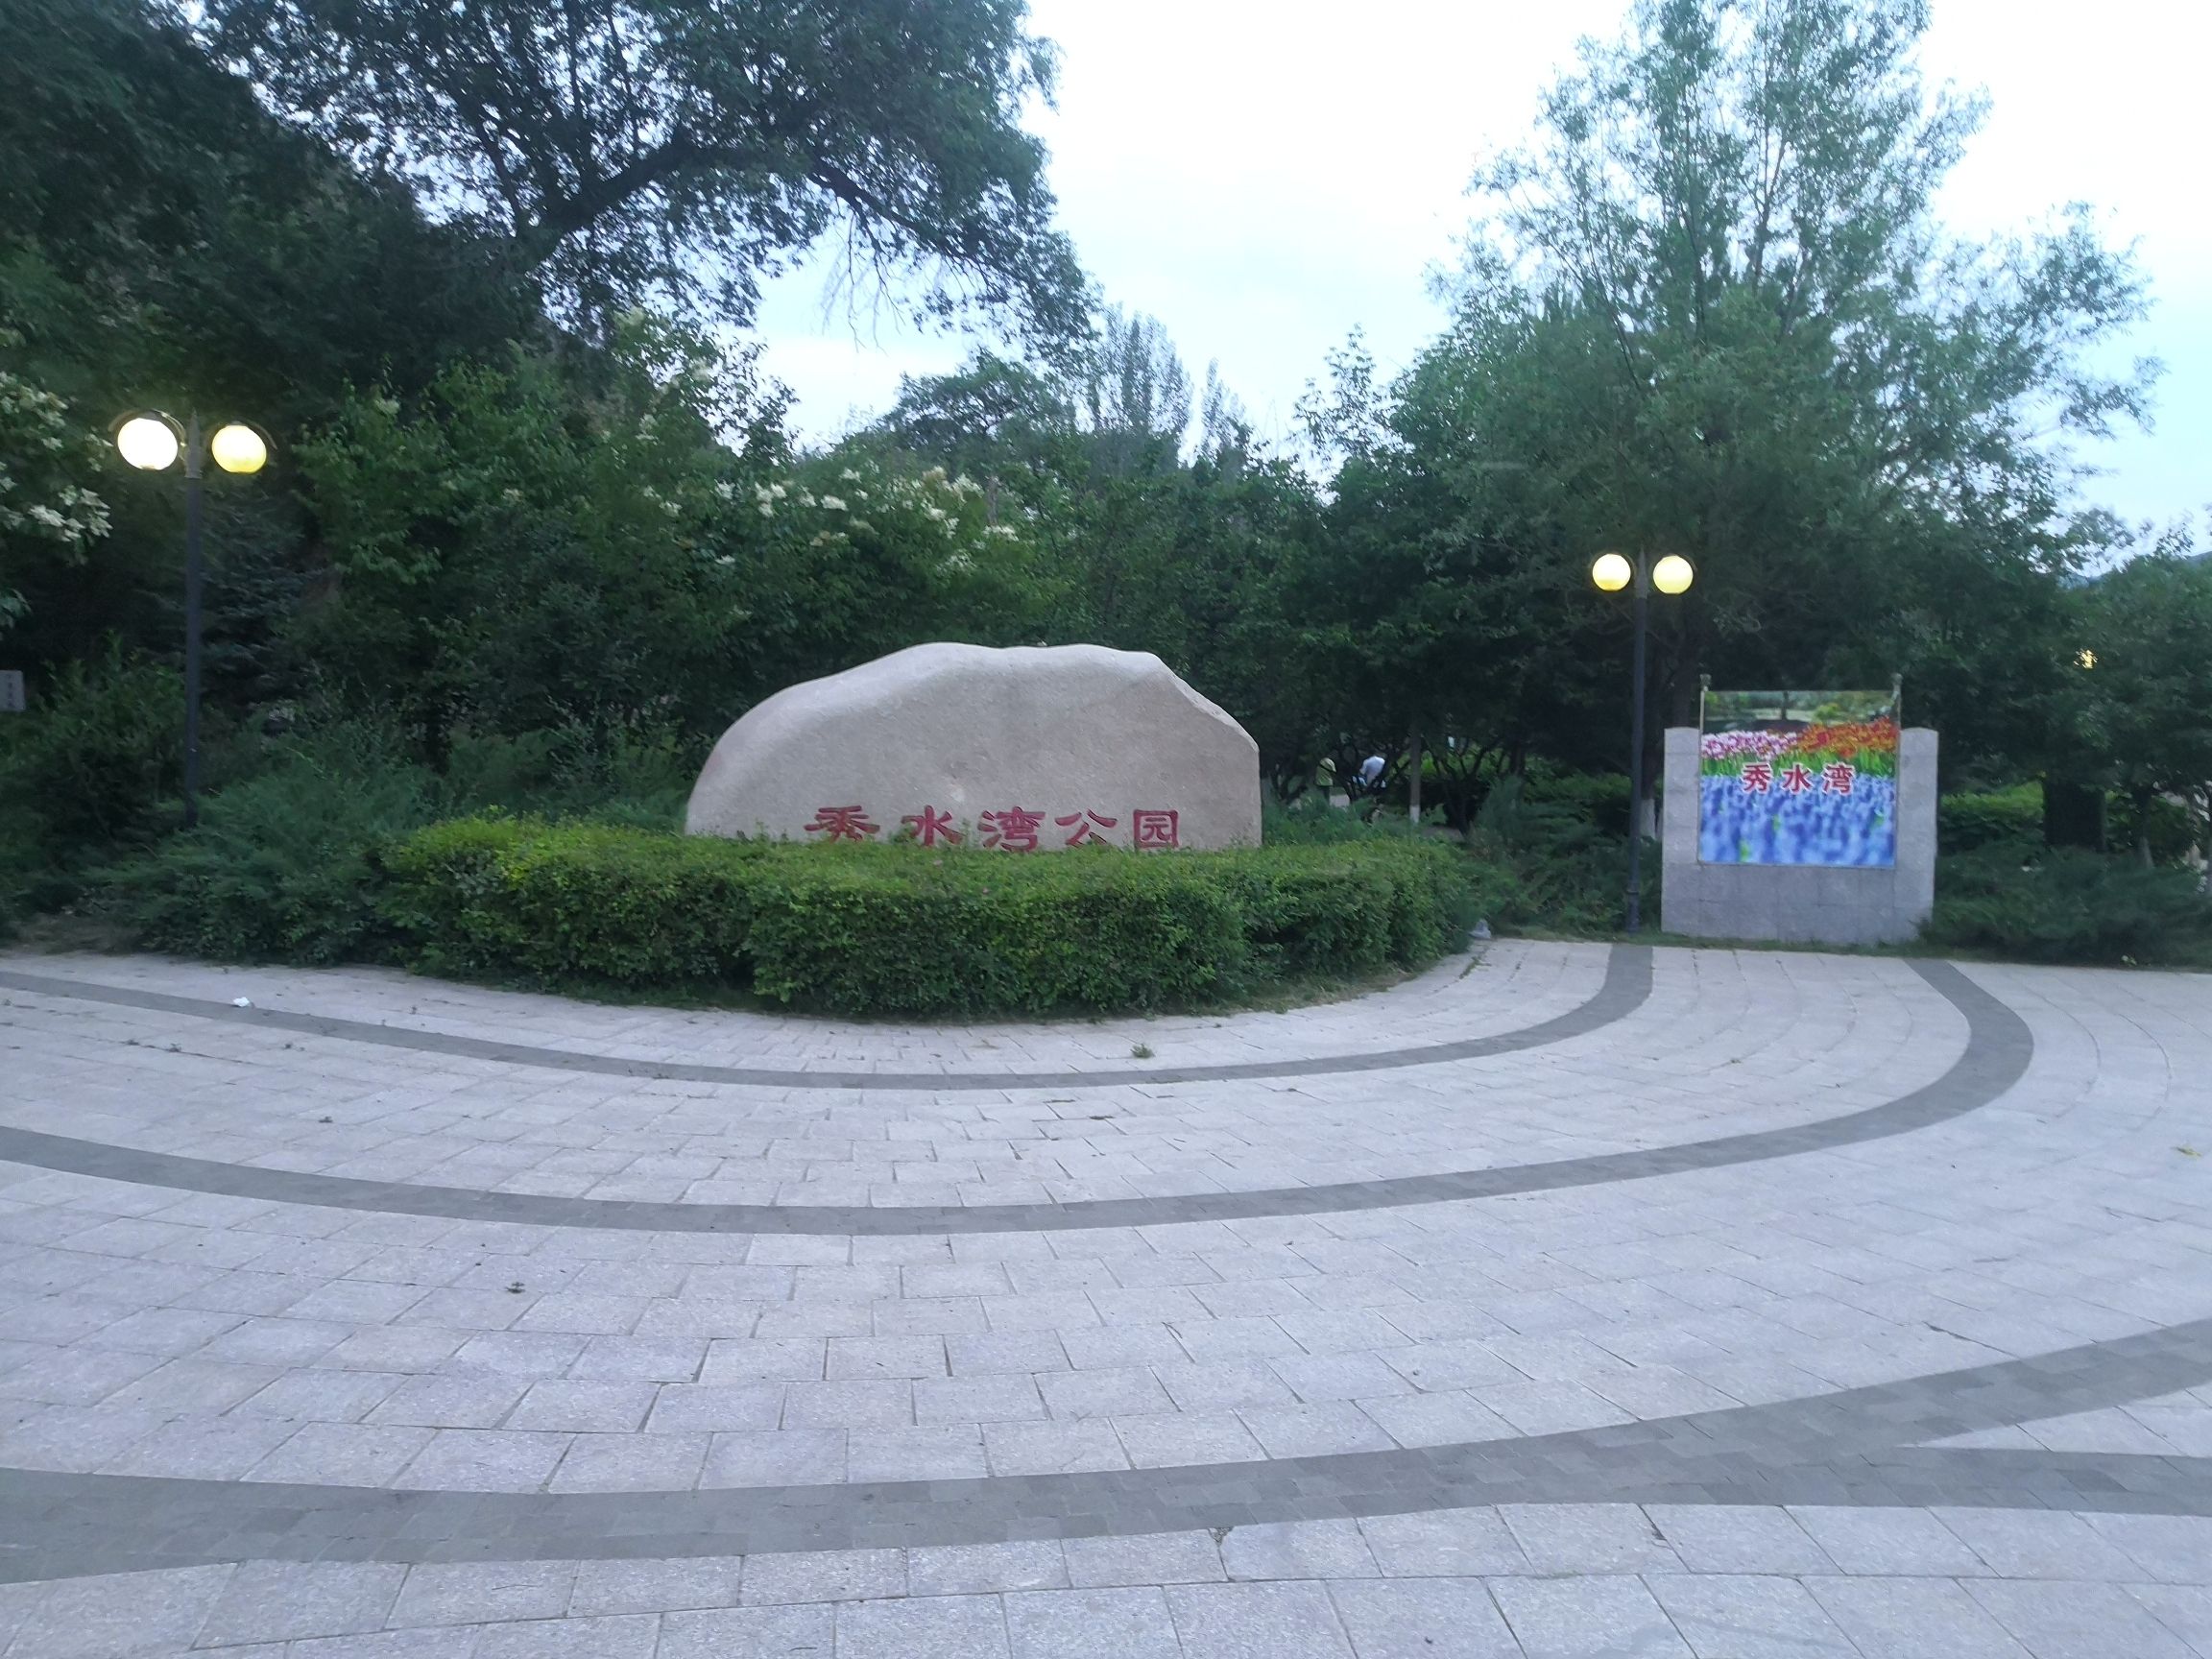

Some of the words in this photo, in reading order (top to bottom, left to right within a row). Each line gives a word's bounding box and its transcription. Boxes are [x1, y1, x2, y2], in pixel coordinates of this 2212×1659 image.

[1743, 763, 1854, 794] 秀水湾
[805, 805, 1179, 852] 秀水湾公园
